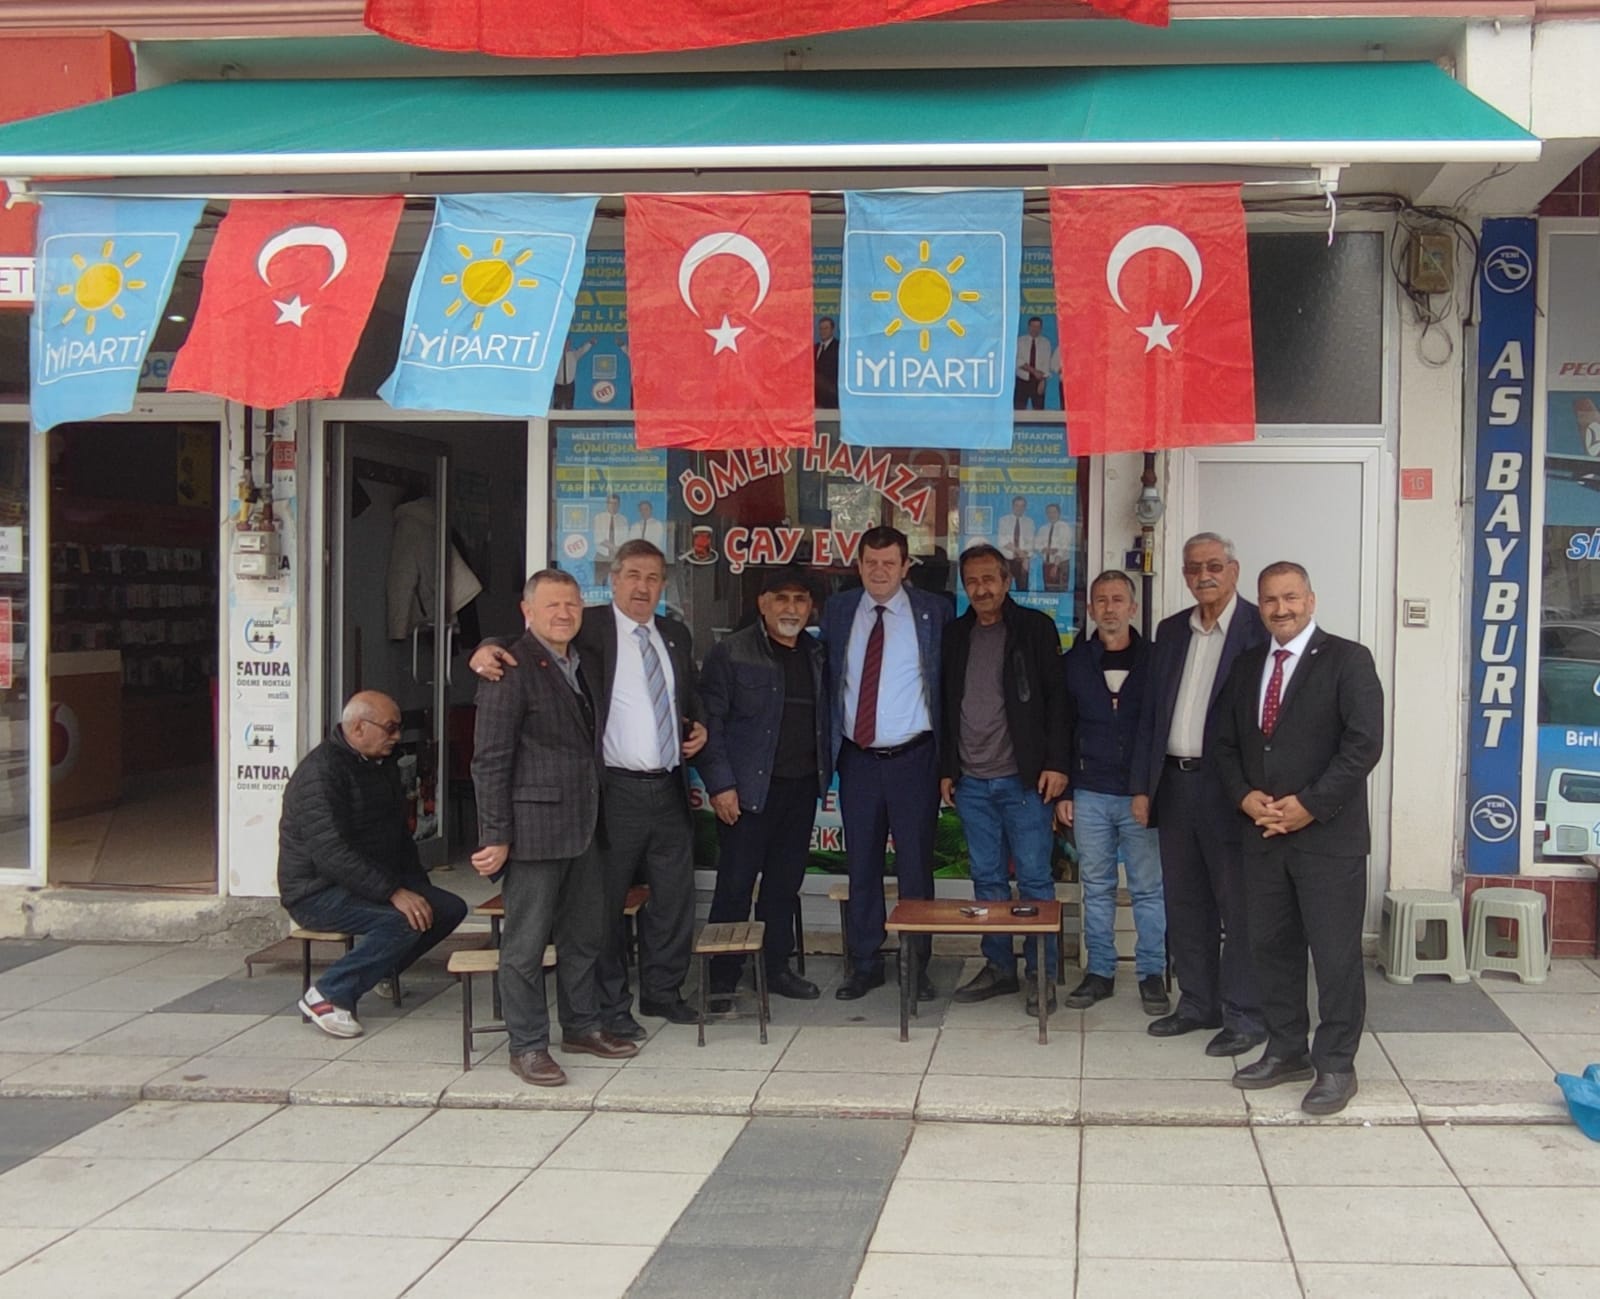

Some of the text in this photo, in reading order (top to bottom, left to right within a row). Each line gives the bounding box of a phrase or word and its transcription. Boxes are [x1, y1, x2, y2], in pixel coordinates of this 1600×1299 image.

[45, 338, 67, 376] İYİ
[67, 329, 146, 369] PARTİ
[405, 323, 541, 364] İYİ PARTİ
[856, 350, 995, 389] İYİ PARTİ
[679, 433, 931, 525] ÖMER HAMZA
[724, 522, 875, 574] ÇAY EV
[1479, 340, 1524, 748] AS BAYBURT
[237, 661, 291, 676] FATURA
[1566, 730, 1600, 747] Birl
[237, 765, 291, 780] FATURA
